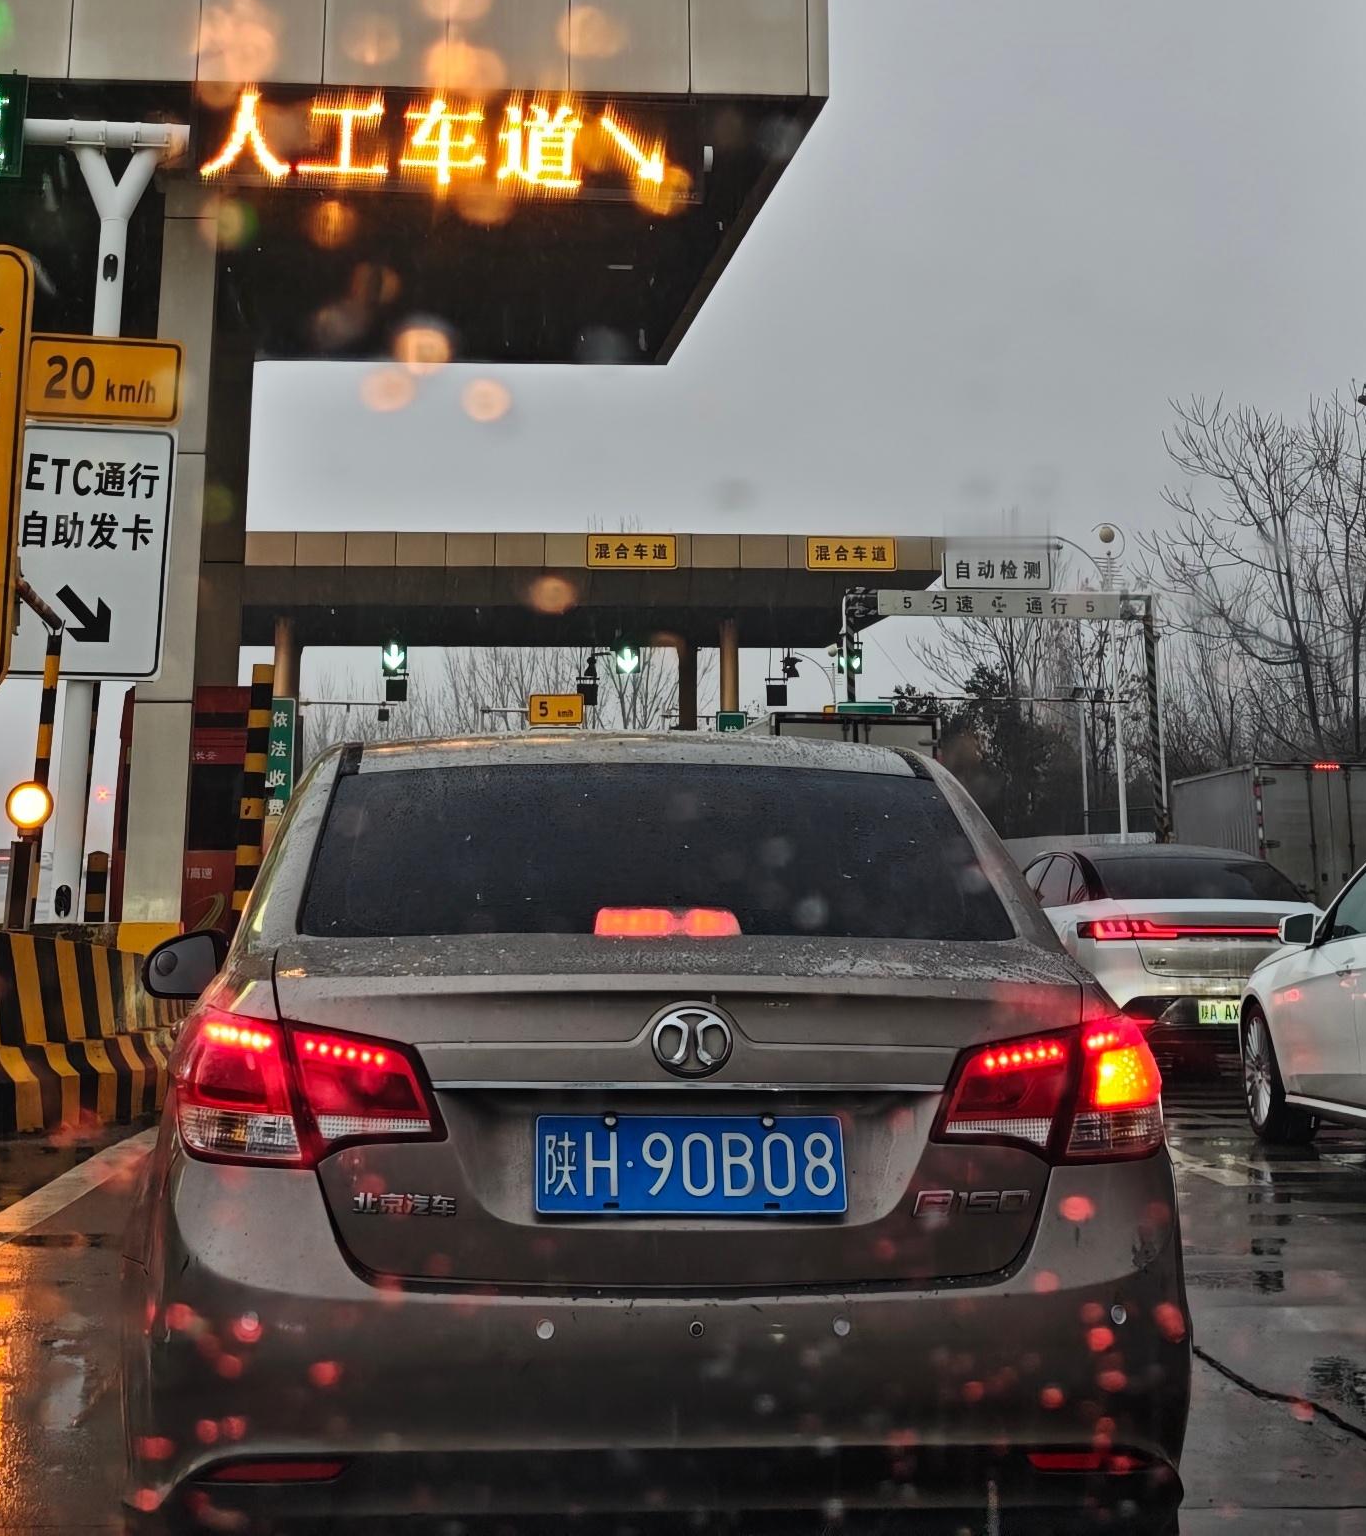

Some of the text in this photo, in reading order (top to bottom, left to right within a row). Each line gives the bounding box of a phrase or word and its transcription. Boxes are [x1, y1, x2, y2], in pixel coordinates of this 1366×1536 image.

[199, 90, 584, 188] 人工车道
[44, 354, 158, 405] 20 km/h
[25, 454, 160, 500] ETC通行
[22, 509, 155, 551] 自助发卡
[595, 543, 668, 560] 混合车道
[815, 545, 887, 562] 混合车道
[955, 560, 1041, 580] 自动检测
[903, 596, 912, 609] 5
[932, 595, 974, 613] 匀速
[1026, 596, 1067, 615] 通行
[1086, 601, 1095, 613] 5
[539, 701, 549, 717] 5
[267, 711, 289, 816] 依法收费
[353, 1192, 456, 1216] 北京汽车
